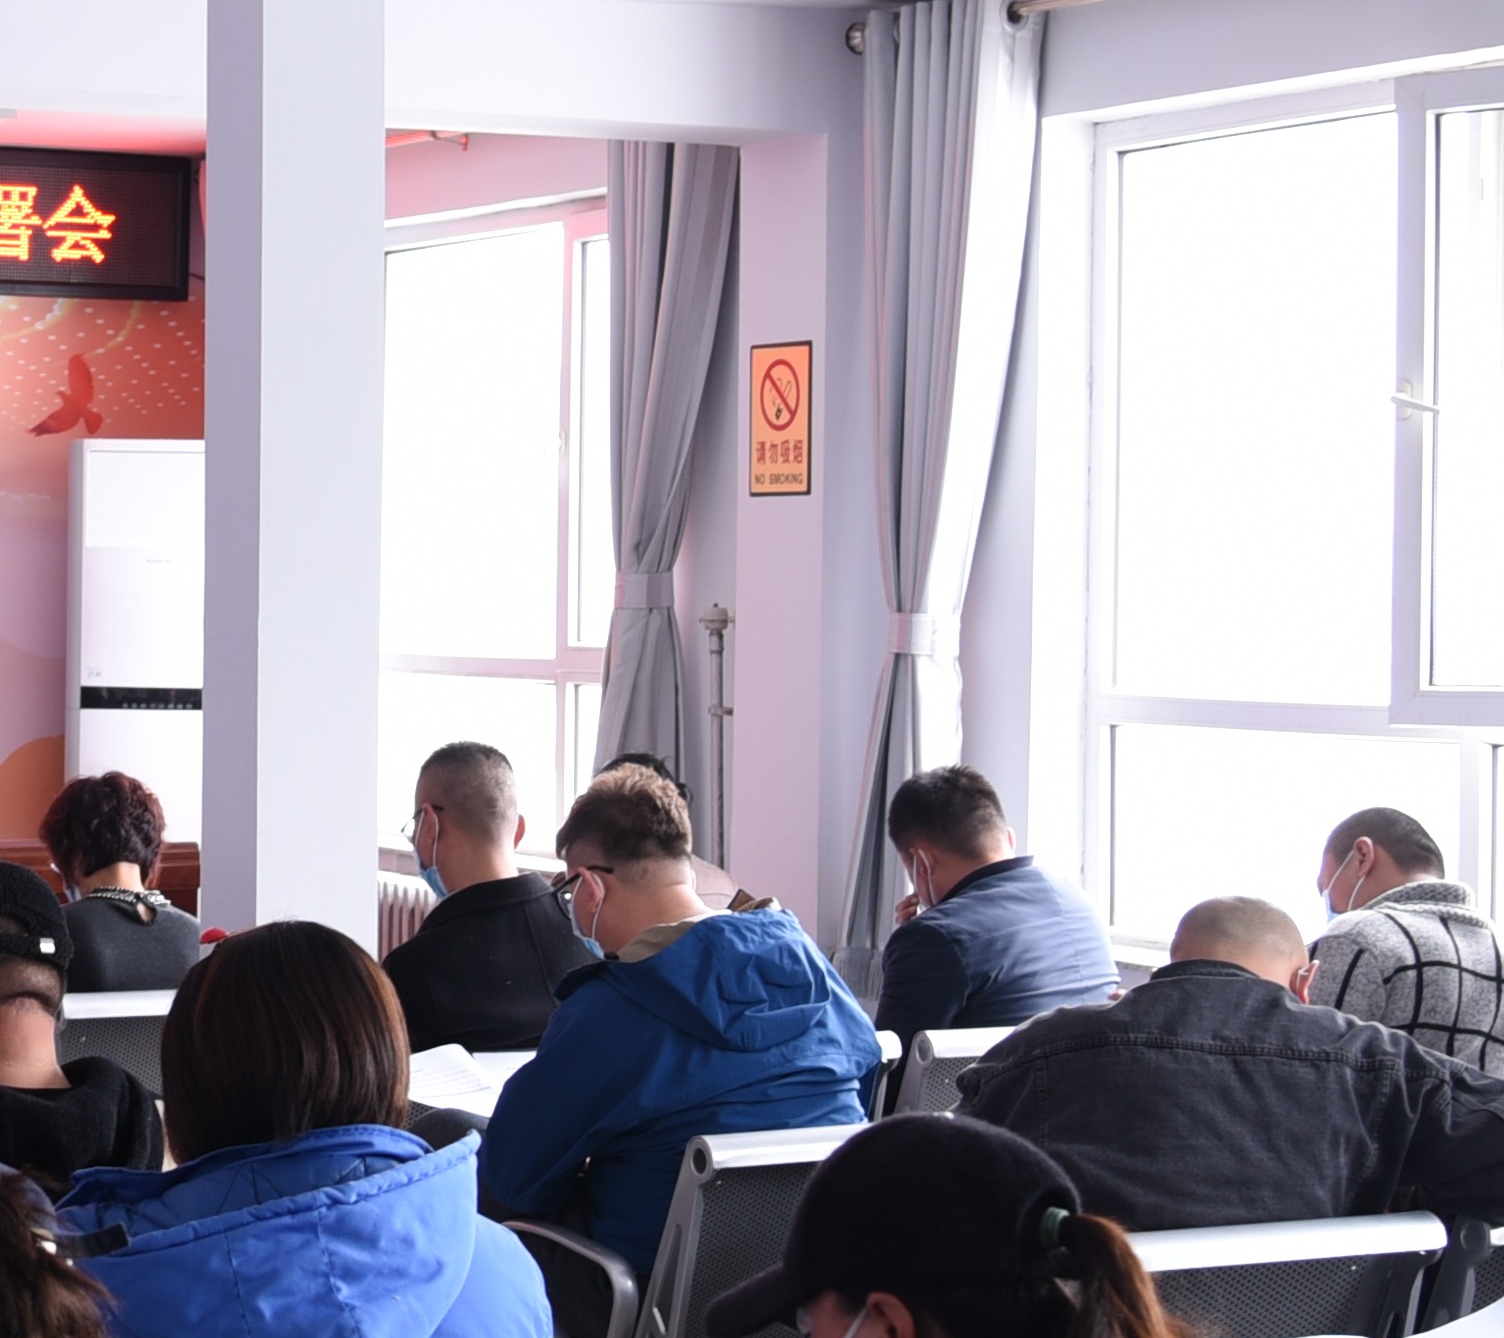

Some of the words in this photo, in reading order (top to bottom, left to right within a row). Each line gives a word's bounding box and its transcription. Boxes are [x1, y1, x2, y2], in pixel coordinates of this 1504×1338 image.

[756, 440, 803, 465] 请勿吸烟
[755, 473, 766, 485] NO
[769, 472, 803, 485] SMOKING
